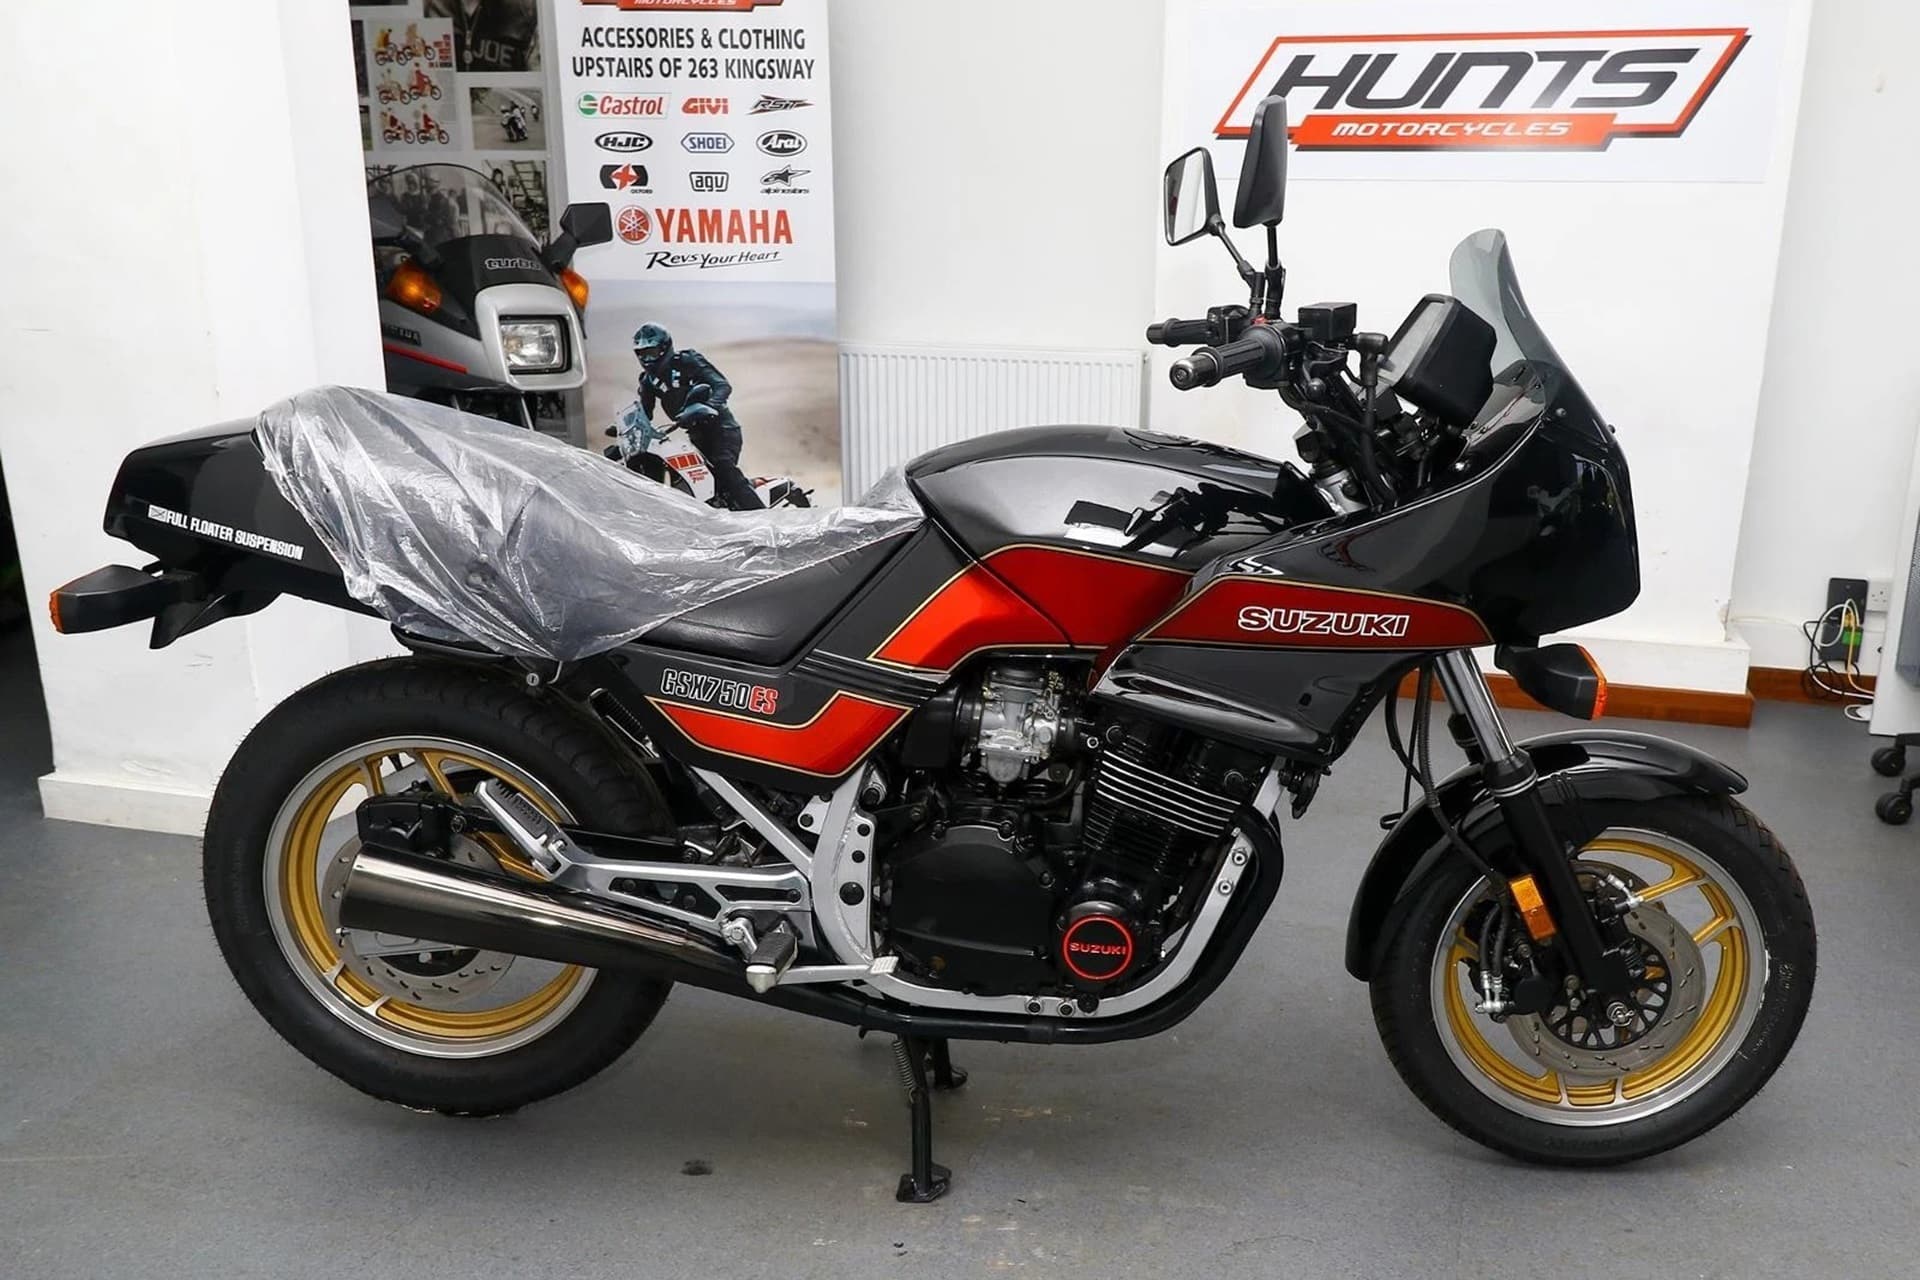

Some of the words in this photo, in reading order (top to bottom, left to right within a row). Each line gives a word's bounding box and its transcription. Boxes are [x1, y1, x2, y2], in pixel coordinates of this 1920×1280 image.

[581, 27, 695, 48] ACCESSORIES
[701, 28, 713, 49] &
[718, 28, 806, 50] CLOTHING
[472, 39, 515, 68] JOE
[572, 56, 654, 78] UPSTAIRS
[659, 57, 683, 79] OF
[688, 57, 719, 79] 263
[724, 58, 816, 81] KINGSWAY
[1266, 47, 1700, 110] HUNTS
[599, 95, 664, 116] Castrol
[681, 97, 729, 115] GIVI
[1331, 121, 1574, 137] MOTORCYCLES
[602, 136, 647, 148] HJC
[689, 136, 727, 149] SHOEI
[766, 133, 801, 150] Arai
[654, 208, 793, 245] YAMAHA
[646, 251, 699, 270] Revs
[699, 252, 739, 269] Your
[737, 251, 781, 264] Heart
[166, 510, 188, 529] FULL
[190, 517, 233, 542] FLOATER
[235, 530, 304, 560] SUSPENSION
[1237, 605, 1410, 638] SUZUKI
[1069, 942, 1127, 956] SUZUKI
